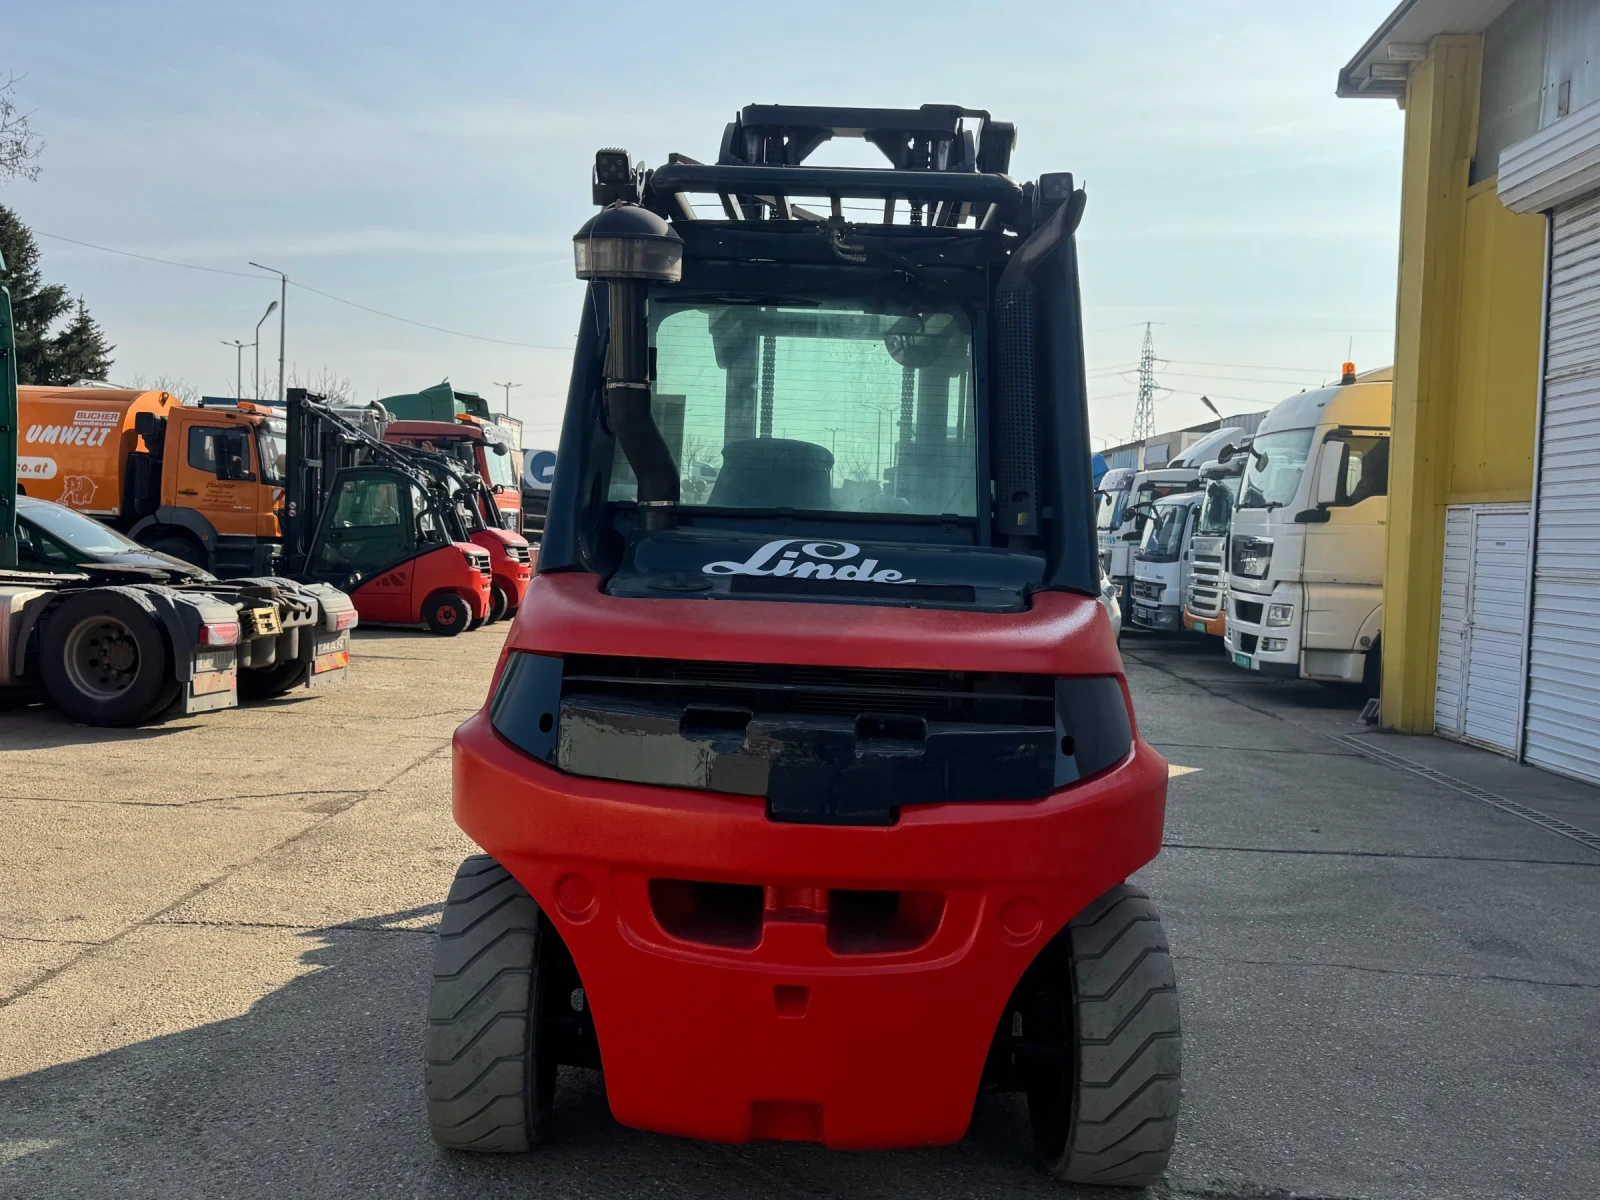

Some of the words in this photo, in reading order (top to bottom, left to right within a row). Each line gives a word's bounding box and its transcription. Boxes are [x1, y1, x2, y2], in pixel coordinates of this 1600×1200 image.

[76, 411, 118, 421] BUCHER
[25, 424, 112, 447] UMWELT
[702, 538, 917, 584] Linde
[322, 637, 346, 651] MAN
